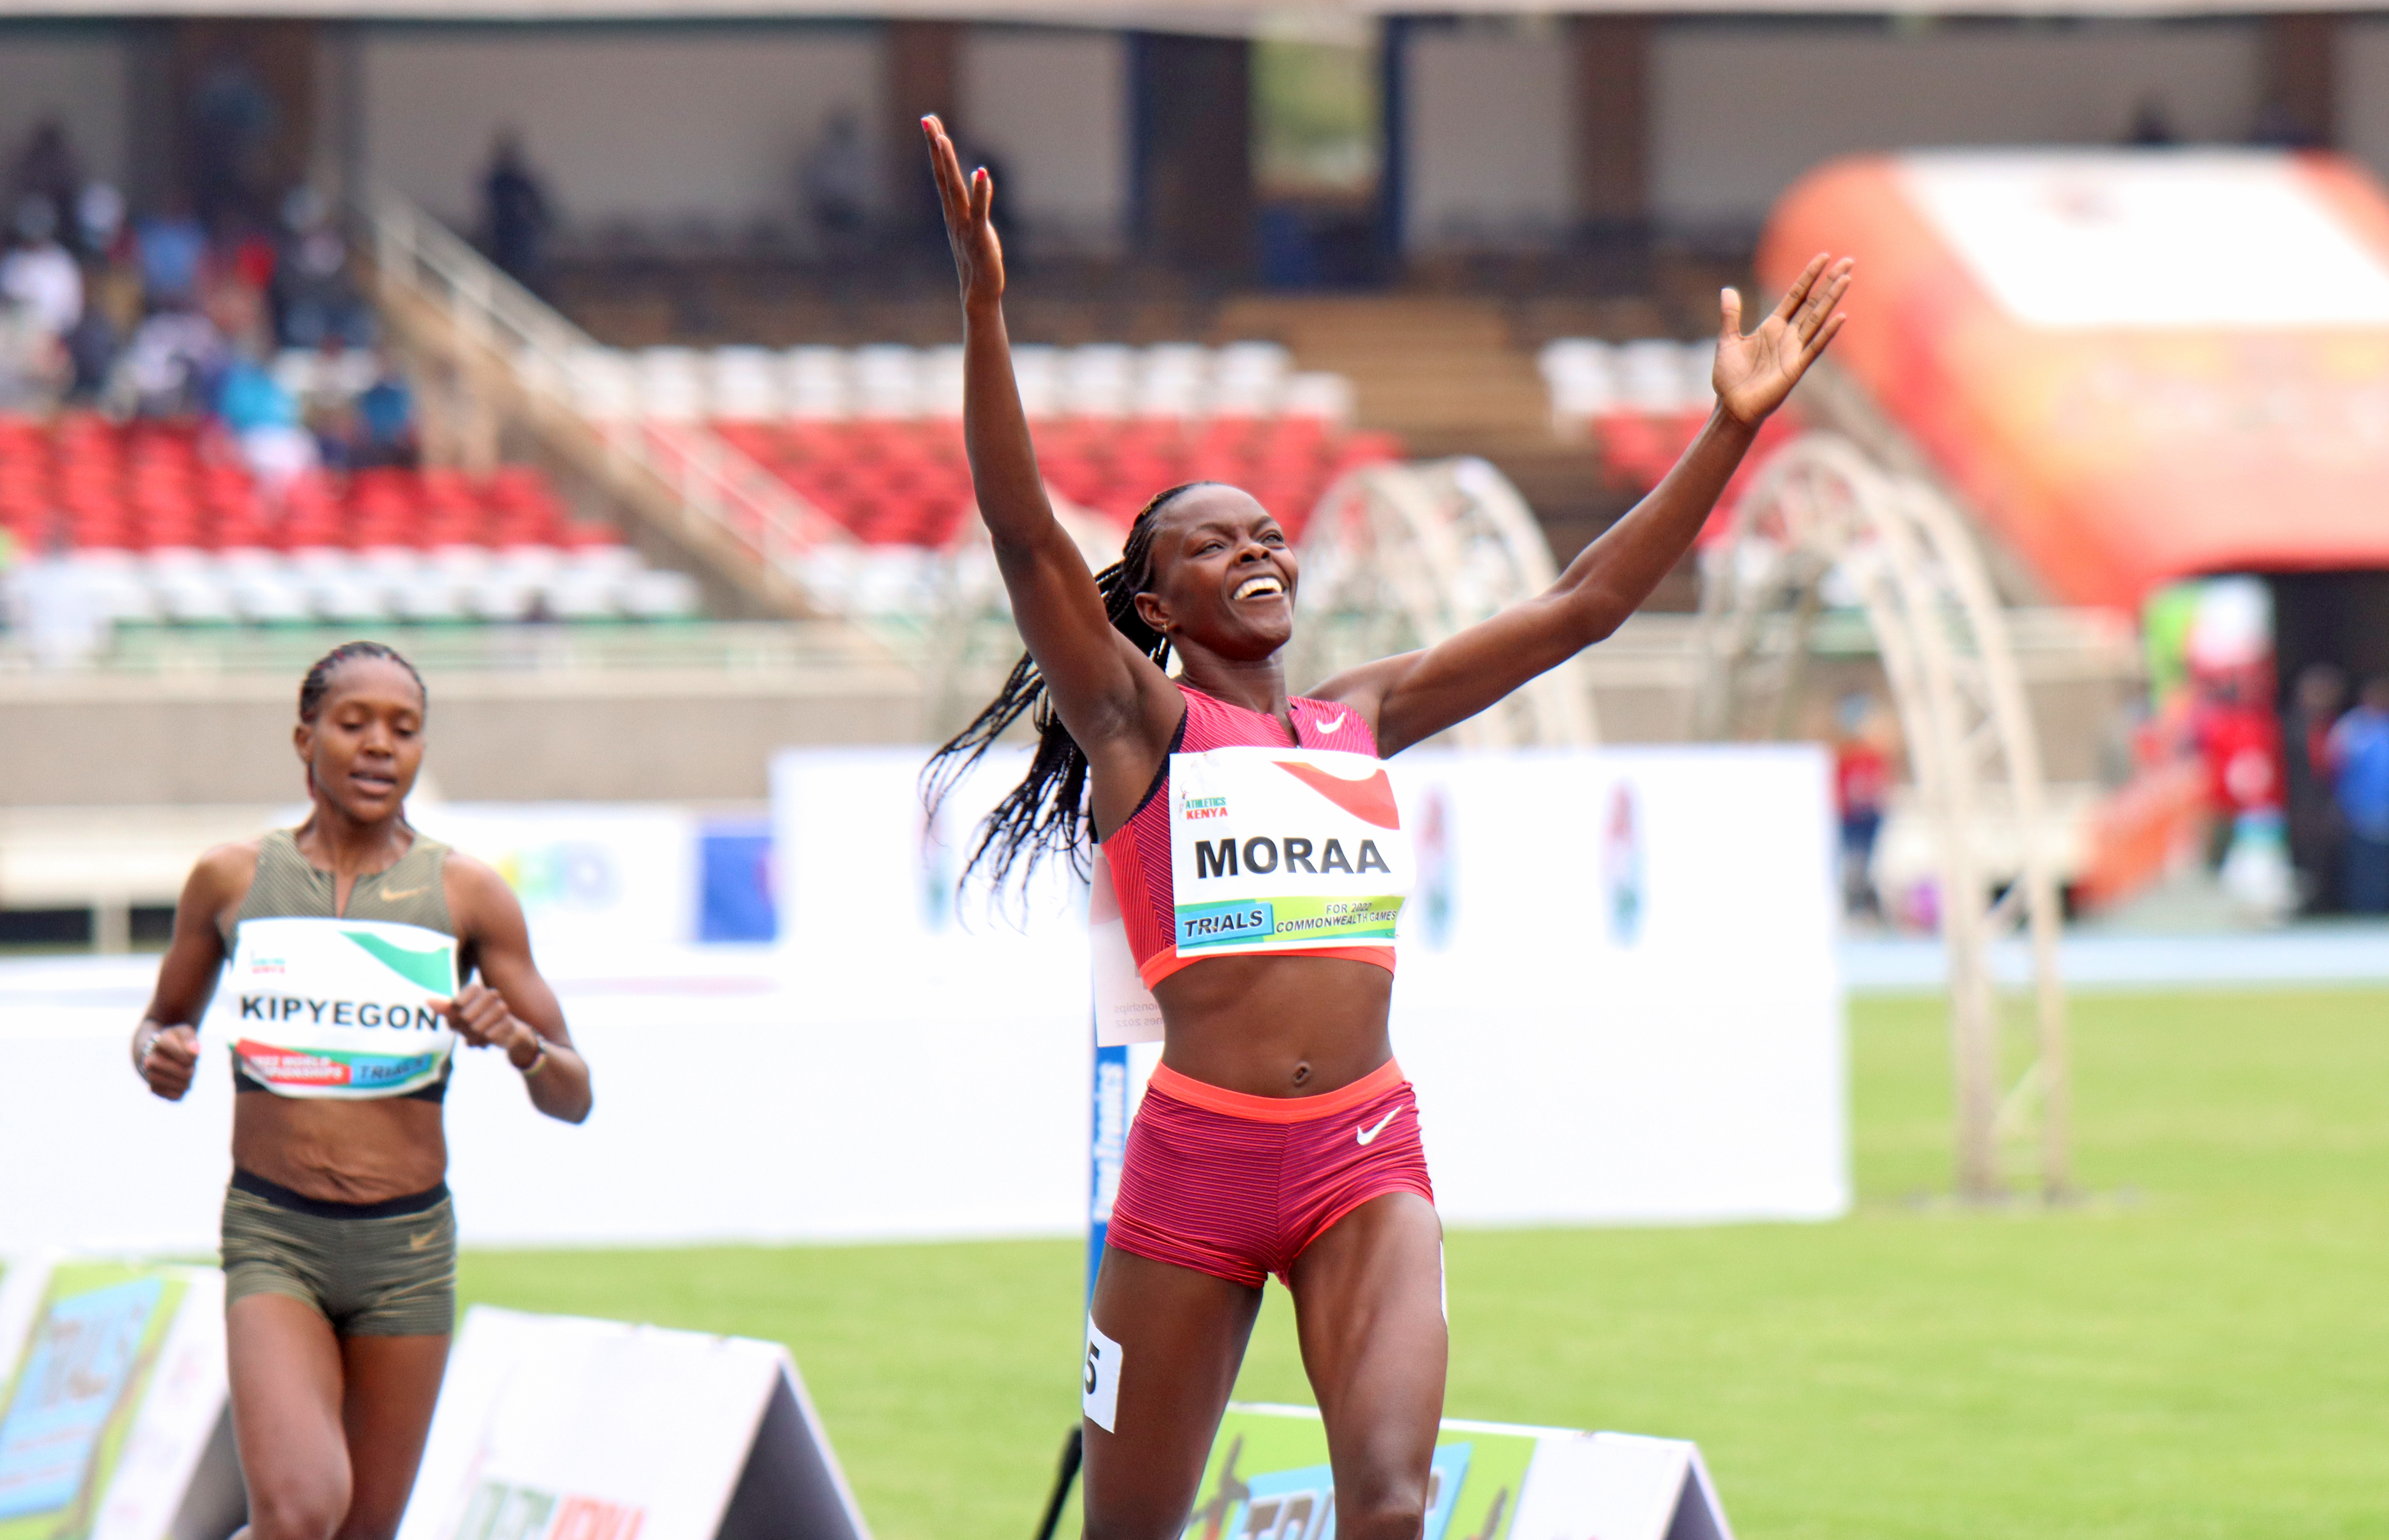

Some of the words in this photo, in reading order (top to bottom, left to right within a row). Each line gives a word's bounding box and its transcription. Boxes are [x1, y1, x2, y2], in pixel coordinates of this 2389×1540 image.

[1186, 797, 1226, 809] ATHLETICS
[1186, 807, 1228, 820] KENYA
[1195, 836, 1391, 879] MORAA
[1326, 903, 1347, 914] FOR
[1351, 903, 1372, 912] 2022
[1183, 909, 1263, 937] TRIALS
[1276, 913, 1367, 933] COMMONWEALTH
[1370, 910, 1396, 921] GAMES
[241, 995, 439, 1031] KIPYEGON
[1085, 1340, 1099, 1395] 5
